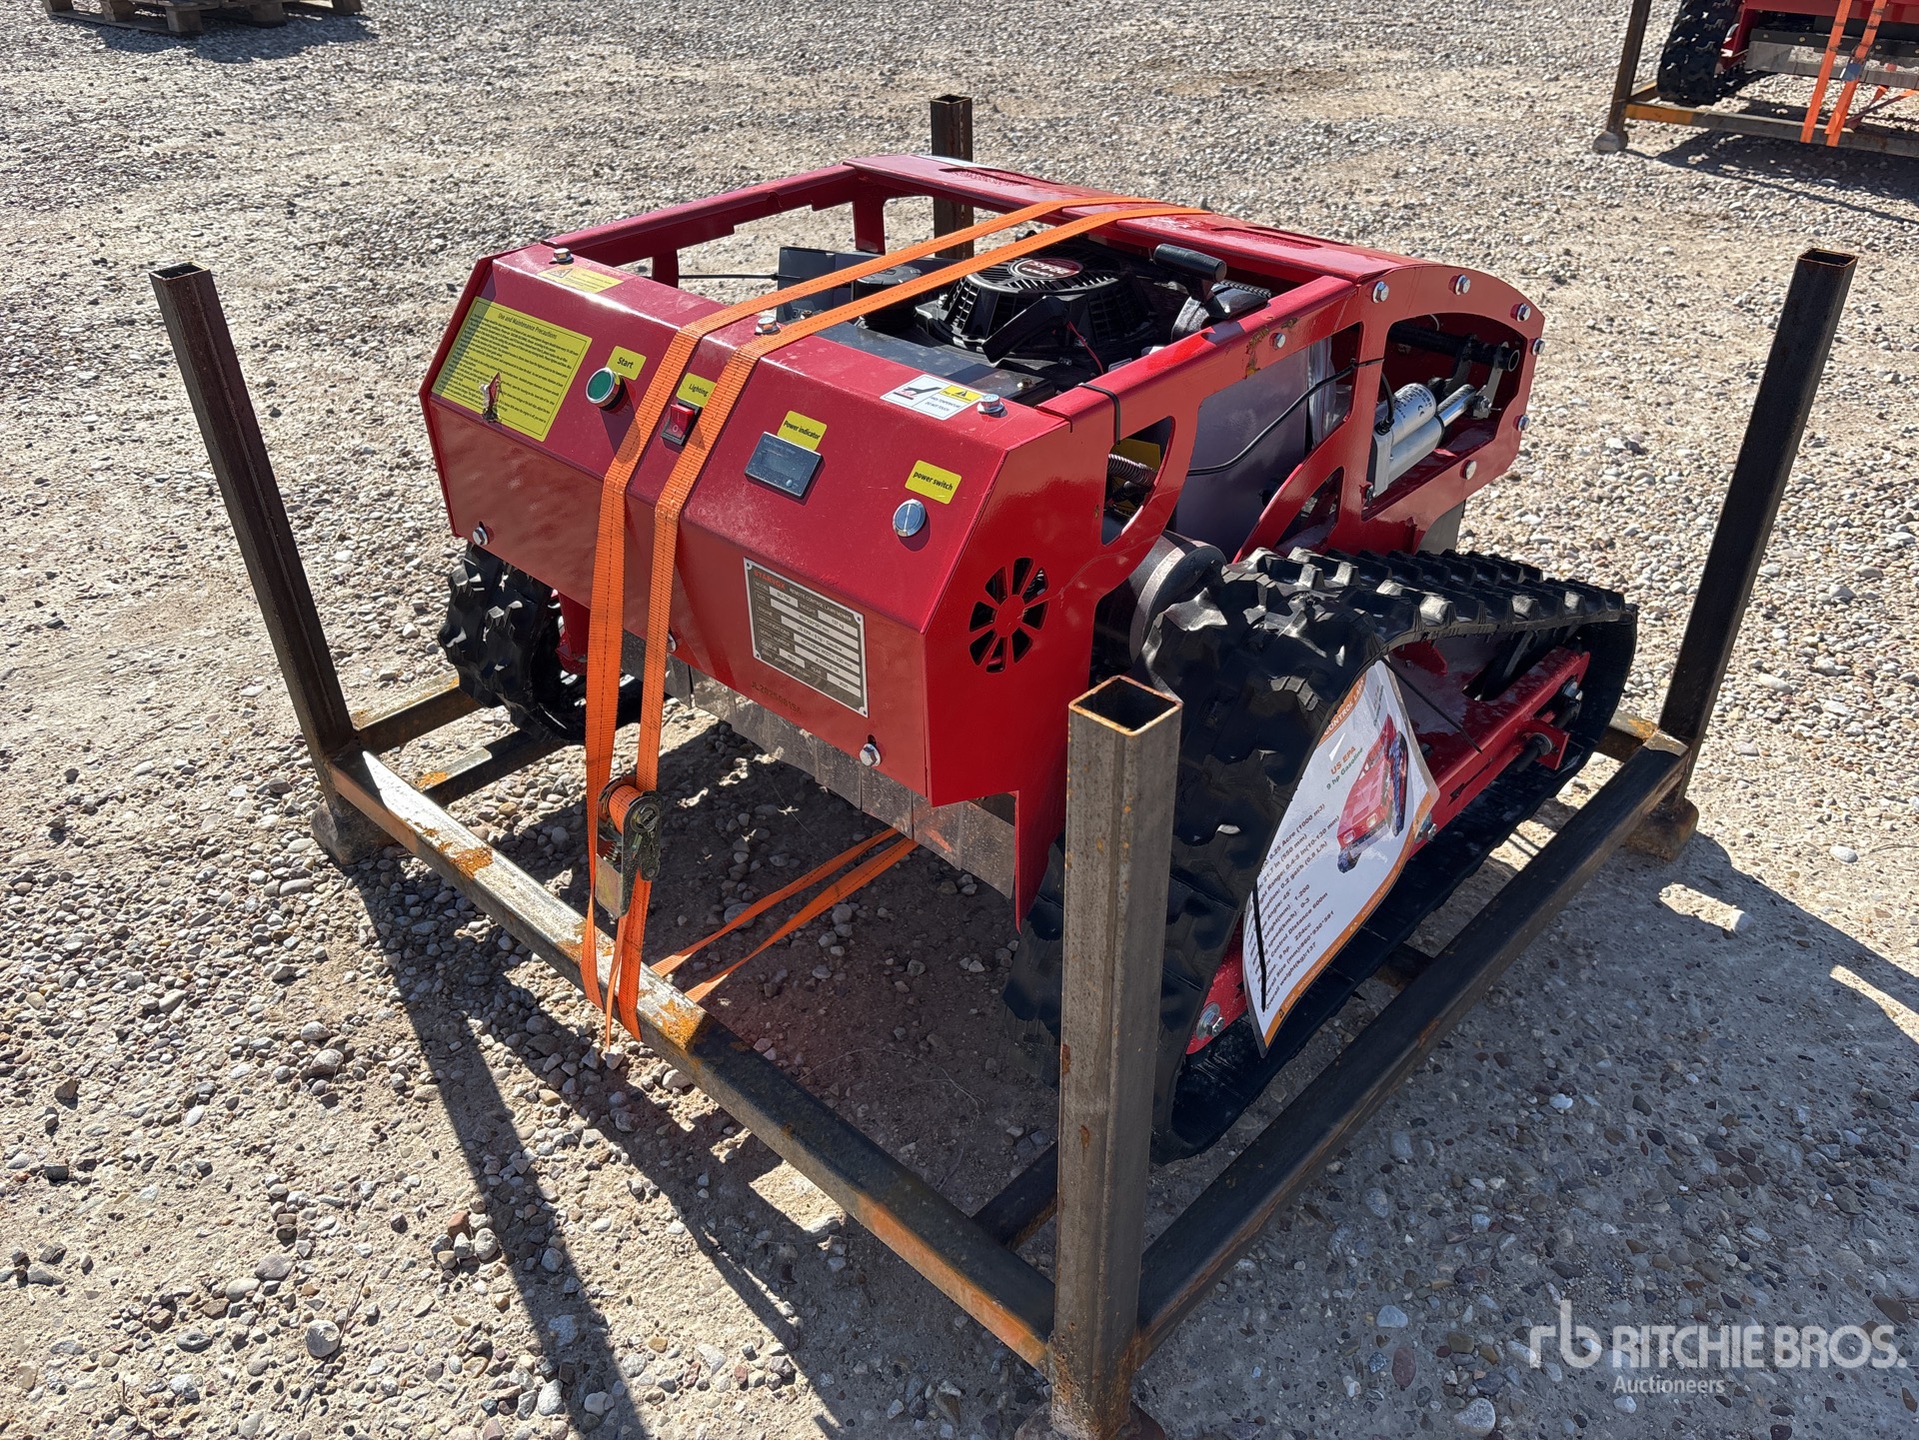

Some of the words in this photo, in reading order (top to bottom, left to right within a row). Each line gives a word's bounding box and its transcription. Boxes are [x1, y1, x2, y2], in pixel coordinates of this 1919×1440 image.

[512, 318, 535, 331] Maintenance
[535, 326, 557, 339] Precautions
[617, 357, 634, 369] Start
[688, 384, 709, 397] Lighting
[783, 420, 800, 433] Power
[798, 425, 821, 440] indicator
[912, 471, 933, 484] power
[933, 476, 954, 491] switch
[805, 595, 823, 608] CONTROL
[835, 609, 851, 622] MOWER
[1330, 760, 1342, 774] US
[1342, 746, 1356, 762] EPA
[1332, 774, 1340, 784] hp
[1340, 746, 1363, 775] Gasoline
[1268, 844, 1281, 859] 0.25
[1283, 830, 1296, 846] Acre
[1296, 814, 1313, 832] (1000
[1263, 866, 1273, 882] 21.7
[1280, 846, 1293, 862] (550
[1293, 833, 1307, 848] mm)
[1267, 868, 1285, 891] Range:
[1326, 814, 1339, 829] mm)
[1281, 877, 1289, 889] 0.2
[1293, 883, 1309, 901] 1-200
[1267, 898, 1282, 920] Angle:
[1300, 896, 1309, 909] 0-3
[1270, 933, 1288, 957] Control
[1288, 908, 1312, 935] Distance
[1312, 891, 1328, 909] 600m
[1294, 921, 1311, 941] 224cc
[1276, 963, 1286, 977] Size
[1266, 984, 1280, 1009] Overall
